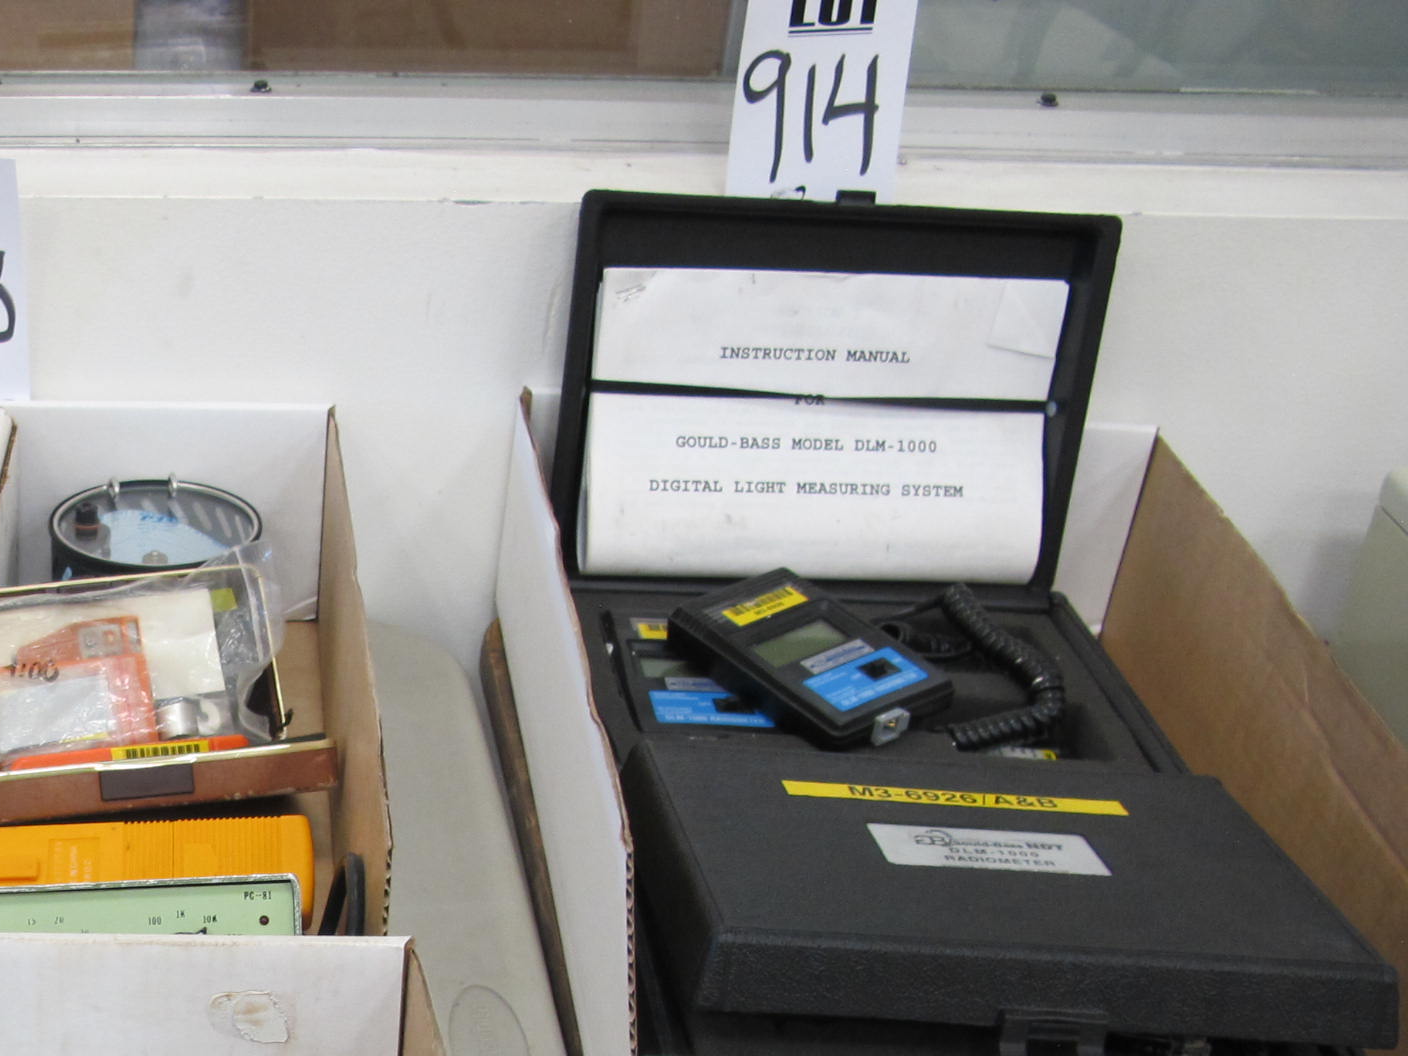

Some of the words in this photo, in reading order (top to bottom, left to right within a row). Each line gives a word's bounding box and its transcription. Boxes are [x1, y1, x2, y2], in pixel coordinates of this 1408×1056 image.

[743, 49, 879, 184] 914
[719, 346, 836, 362] INSTRUCTION
[846, 350, 911, 364] MANUAL
[795, 394, 826, 406] FOR
[675, 436, 781, 450] GOULD-BASS
[792, 437, 844, 452] MODEL
[854, 439, 937, 453] DLM-1000
[649, 479, 723, 494] DIGITAL
[734, 480, 786, 495] LIGHT
[797, 482, 891, 496] MEASURING
[902, 483, 963, 498] SYSTEM
[847, 785, 978, 806] M3-6926
[945, 855, 1055, 866] RADIOMETER
